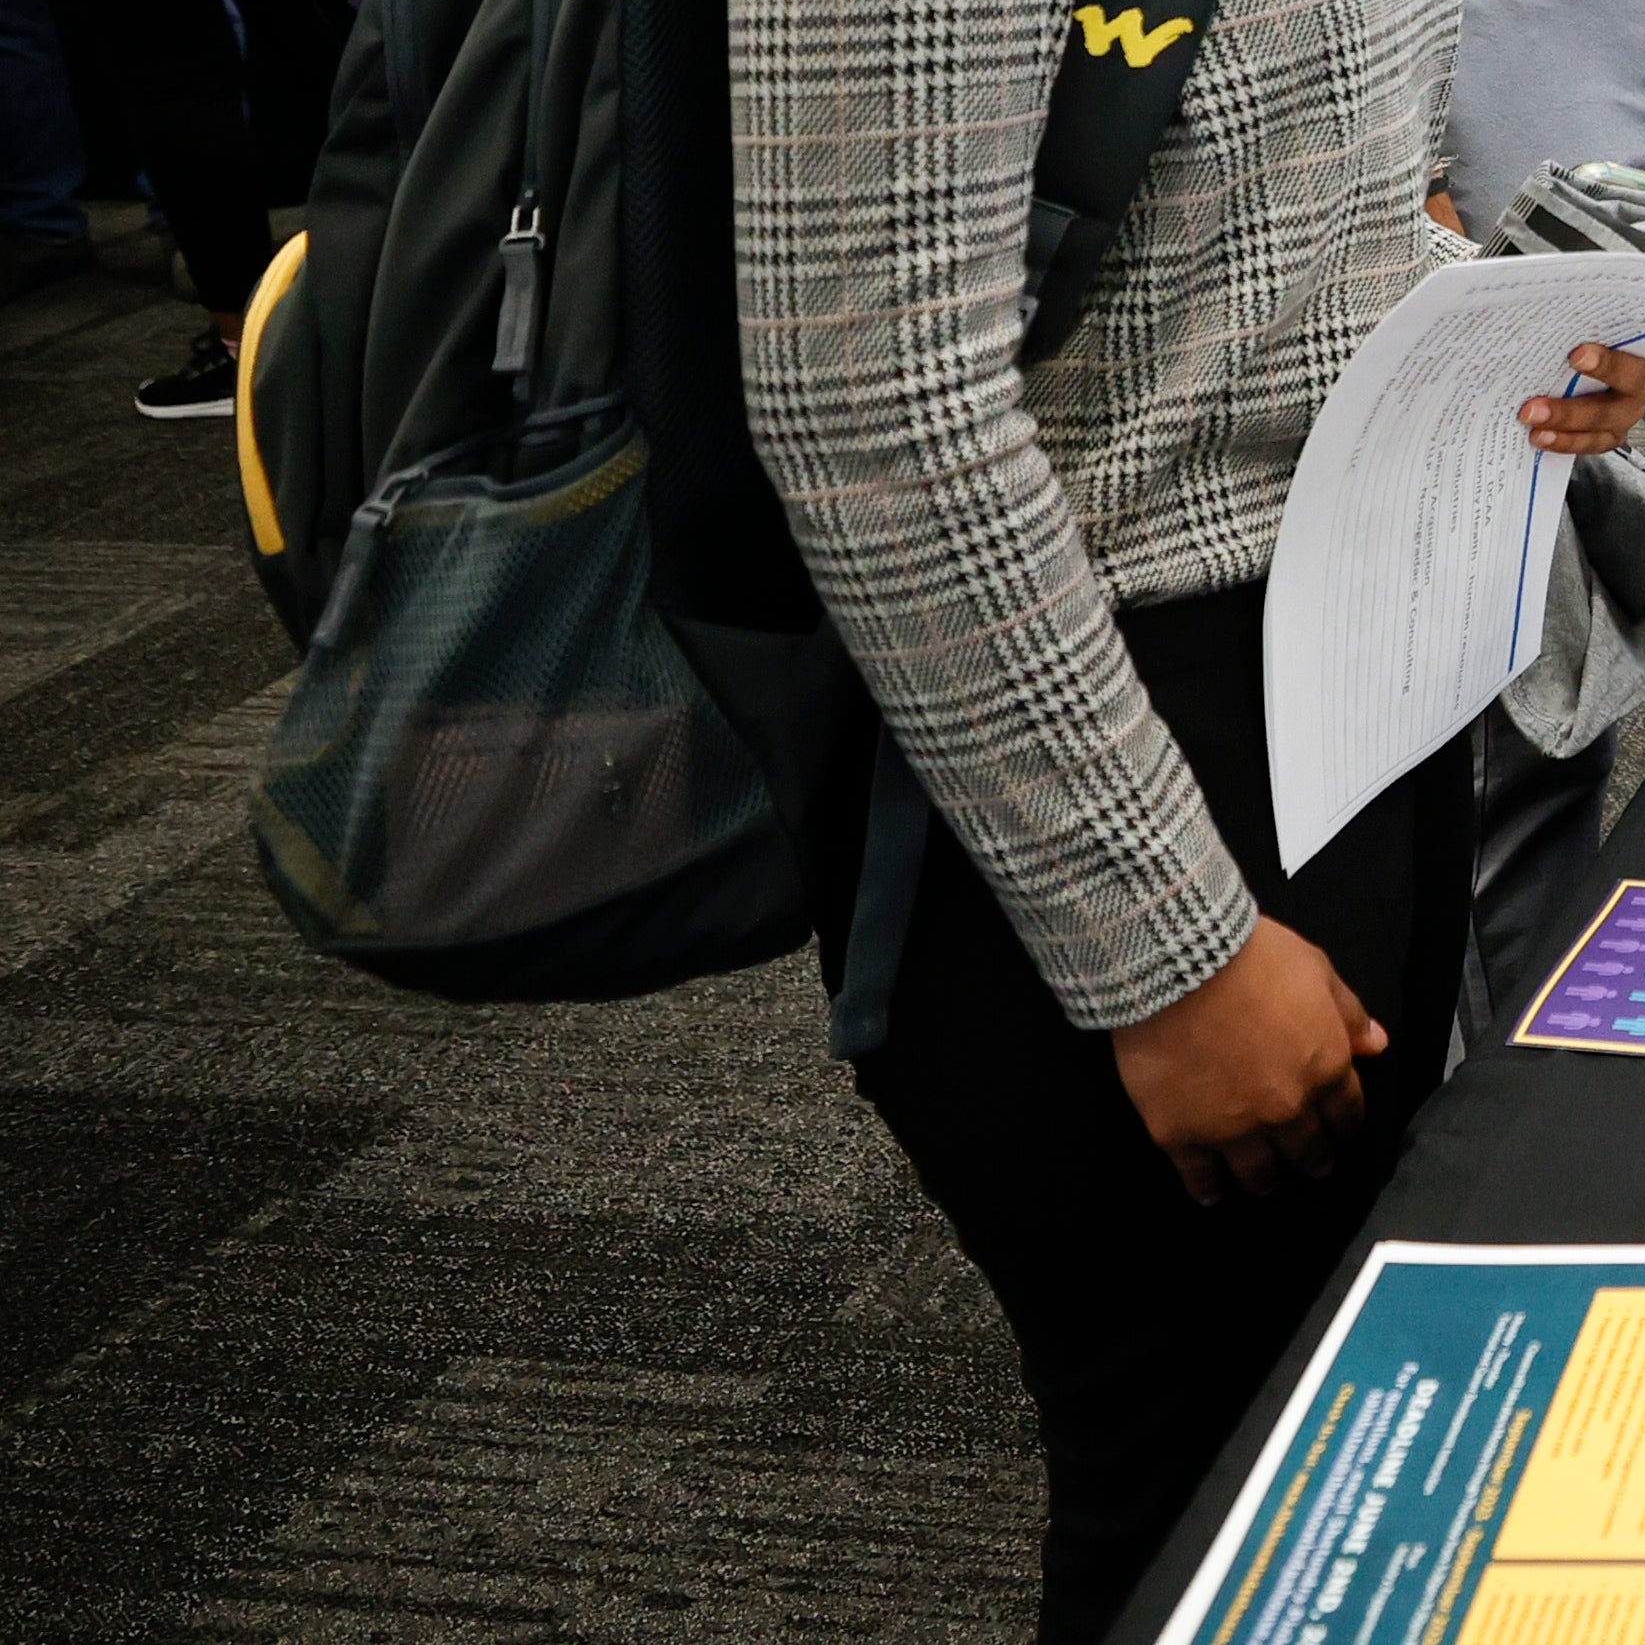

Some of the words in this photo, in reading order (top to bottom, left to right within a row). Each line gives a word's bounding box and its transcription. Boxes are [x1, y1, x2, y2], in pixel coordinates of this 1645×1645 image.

[1365, 1378, 1444, 1488] DEADLINE
[1335, 1491, 1392, 1554] JUNE
[1304, 1557, 1362, 1620] 2ND,
